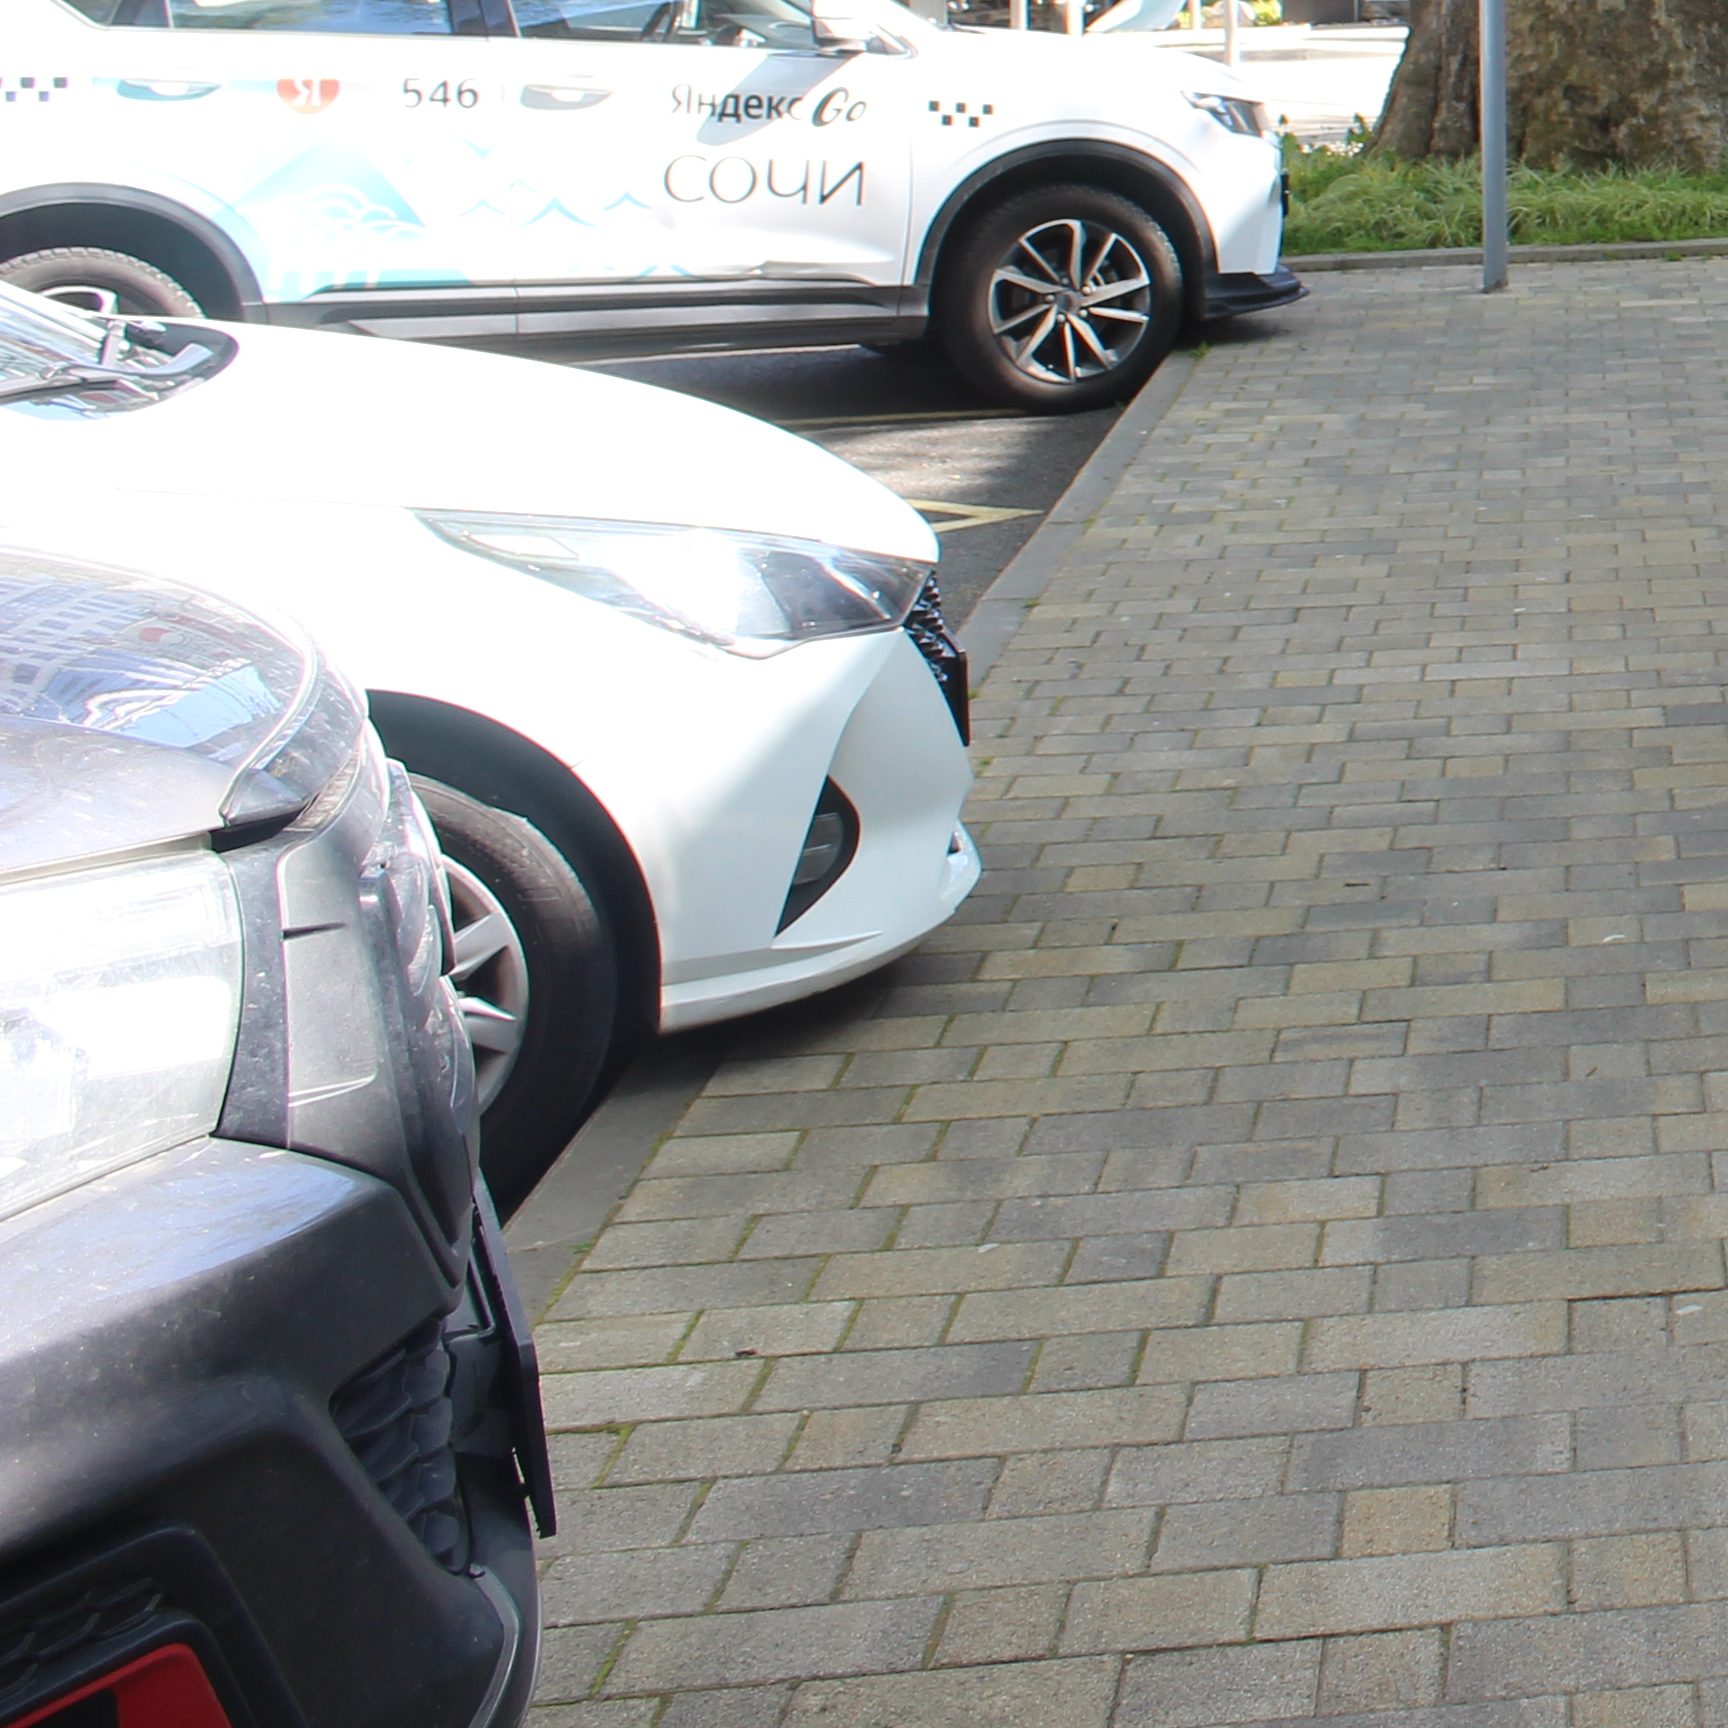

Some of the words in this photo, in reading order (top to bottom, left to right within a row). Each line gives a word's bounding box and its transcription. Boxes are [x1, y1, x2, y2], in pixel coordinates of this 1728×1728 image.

[402, 77, 480, 109] 546
[670, 83, 804, 123] Яндекс
[811, 86, 868, 128] Go
[664, 155, 866, 207] СОЧИ
